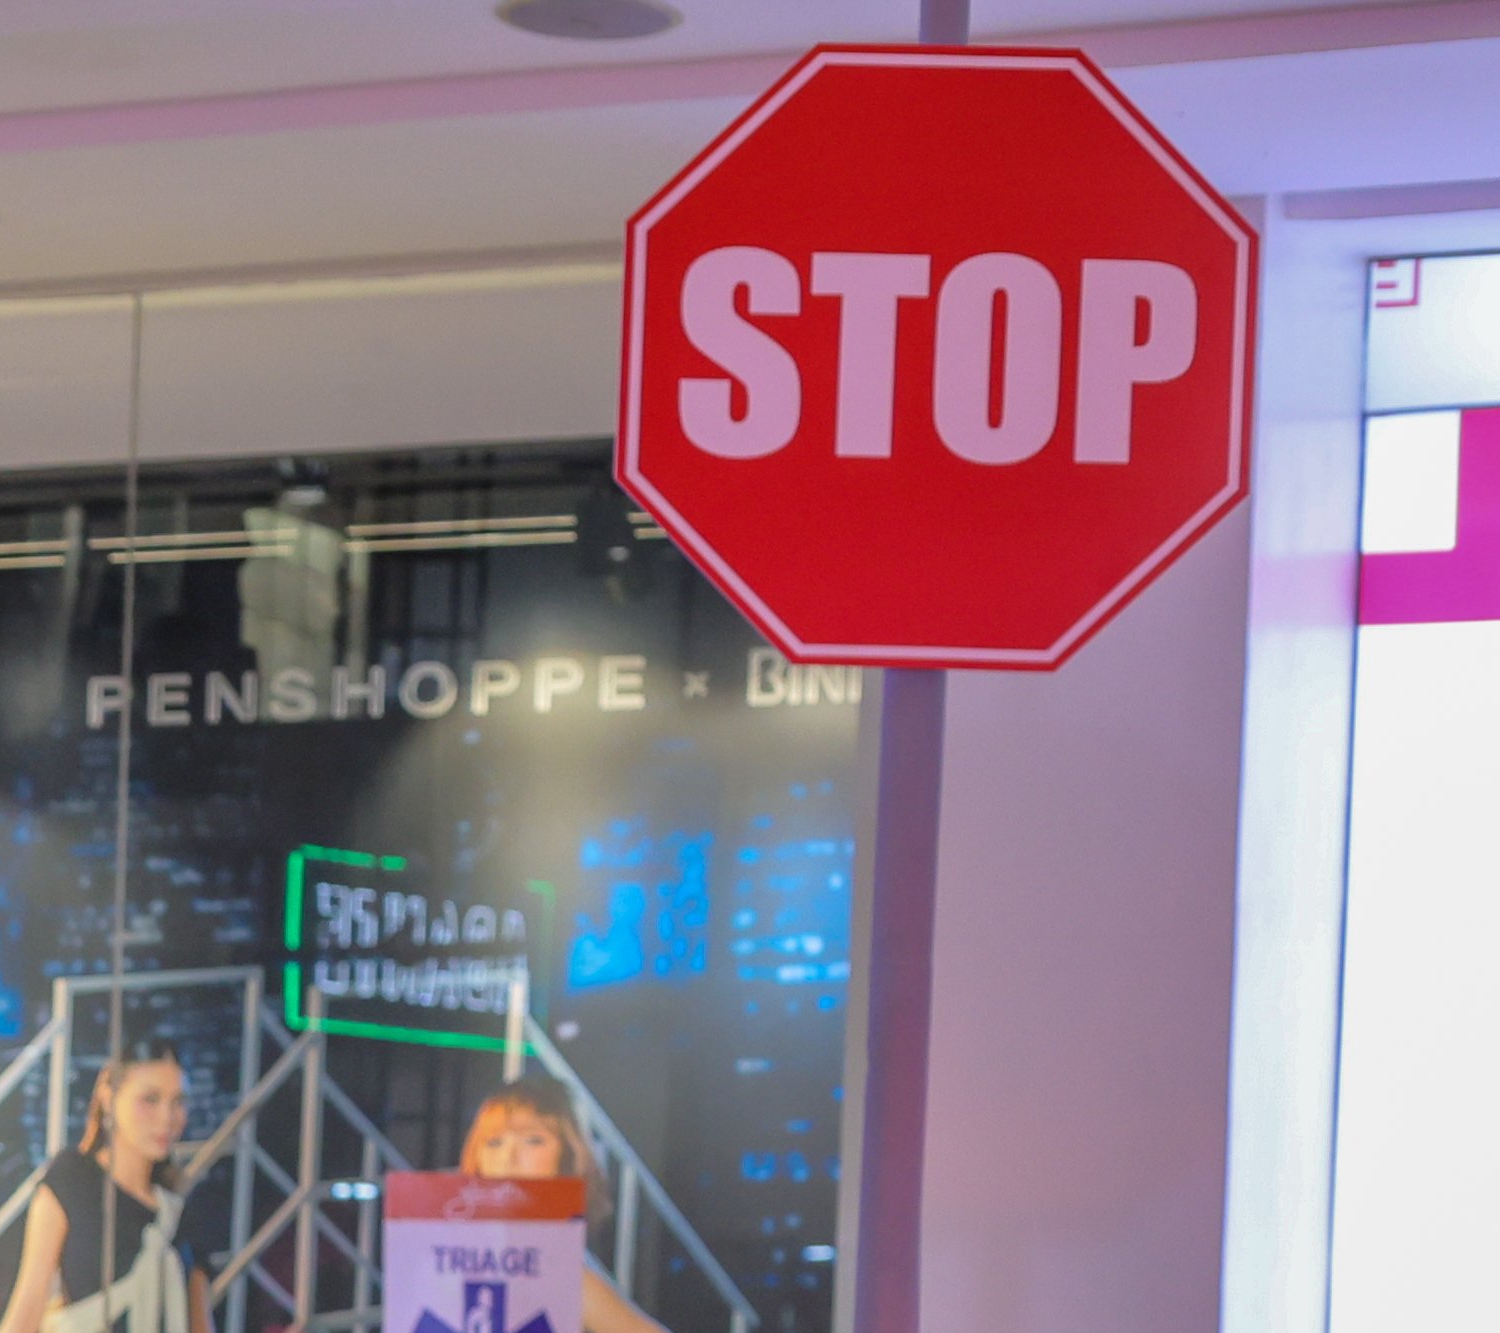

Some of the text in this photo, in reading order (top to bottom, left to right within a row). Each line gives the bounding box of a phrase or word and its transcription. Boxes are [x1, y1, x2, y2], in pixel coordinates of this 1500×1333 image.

[677, 245, 1198, 466] STOP
[86, 654, 647, 729] PENSHOPPE
[431, 1245, 542, 1277] TRIAGE
